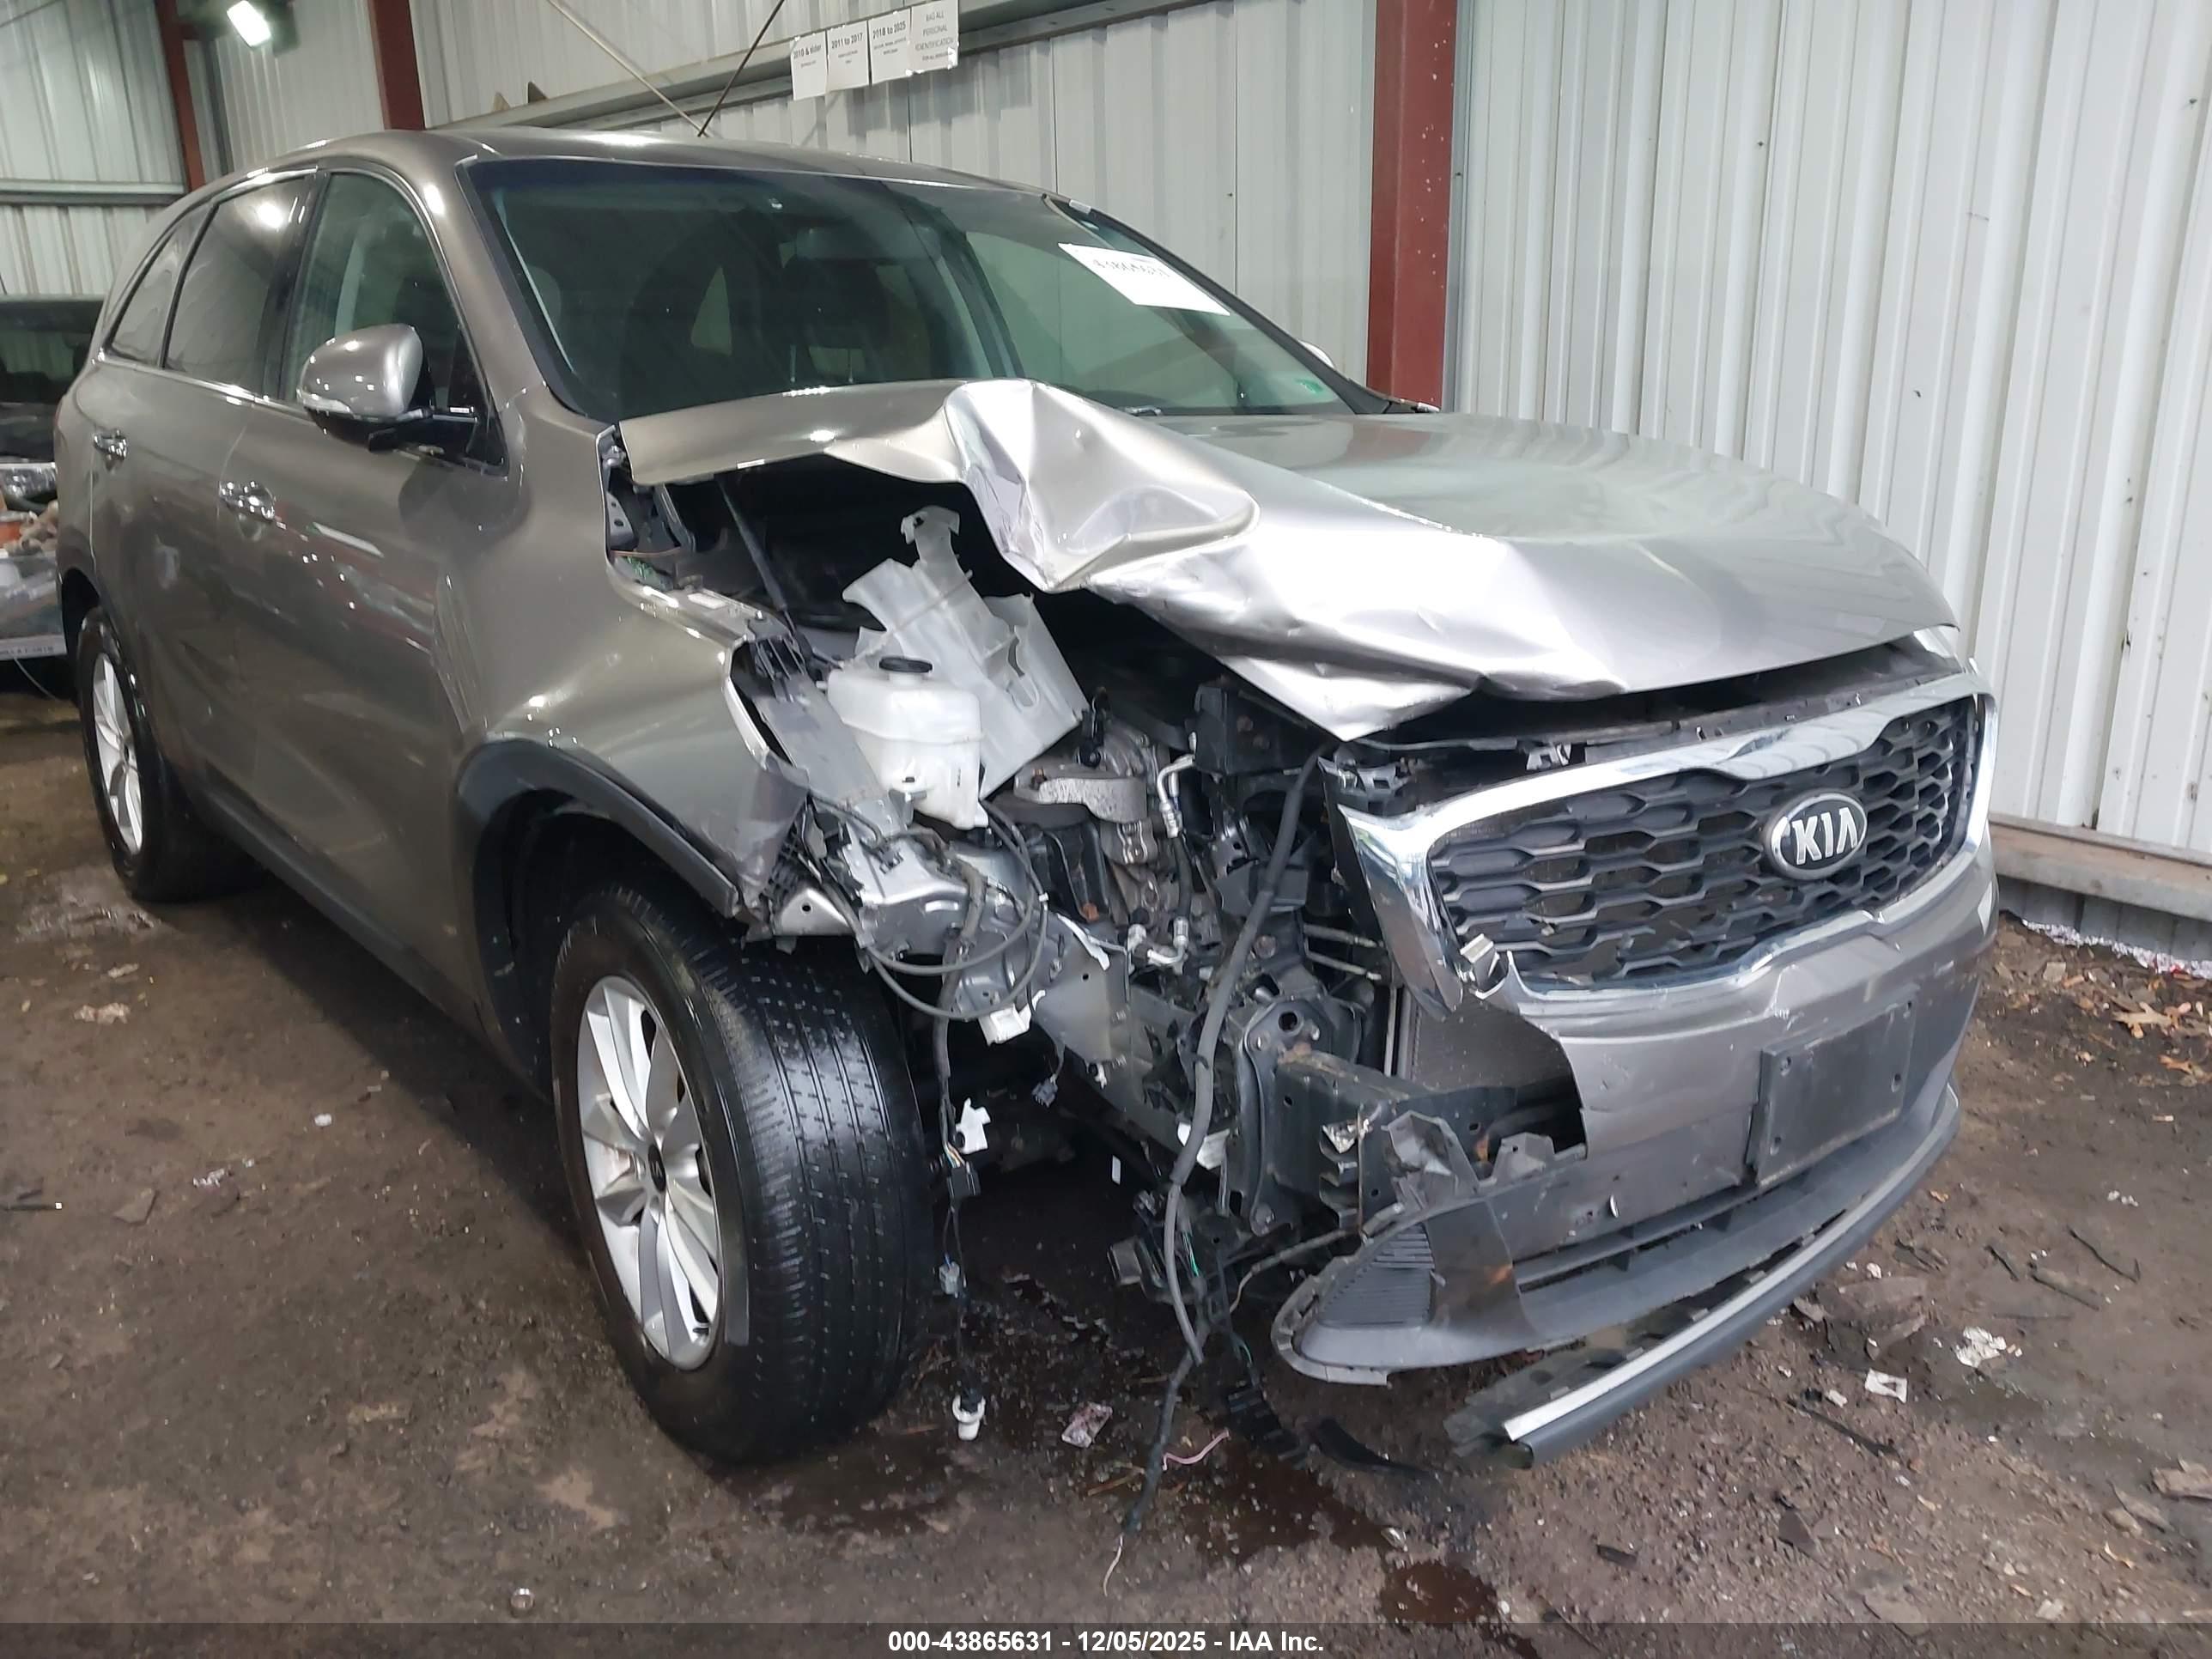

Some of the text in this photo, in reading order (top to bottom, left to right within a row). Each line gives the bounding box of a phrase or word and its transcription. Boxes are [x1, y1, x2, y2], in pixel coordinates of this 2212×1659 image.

[831, 38, 844, 49] 2011
[844, 37, 850, 46] to
[851, 33, 863, 44] 2017
[1791, 806, 1858, 866] KIA
